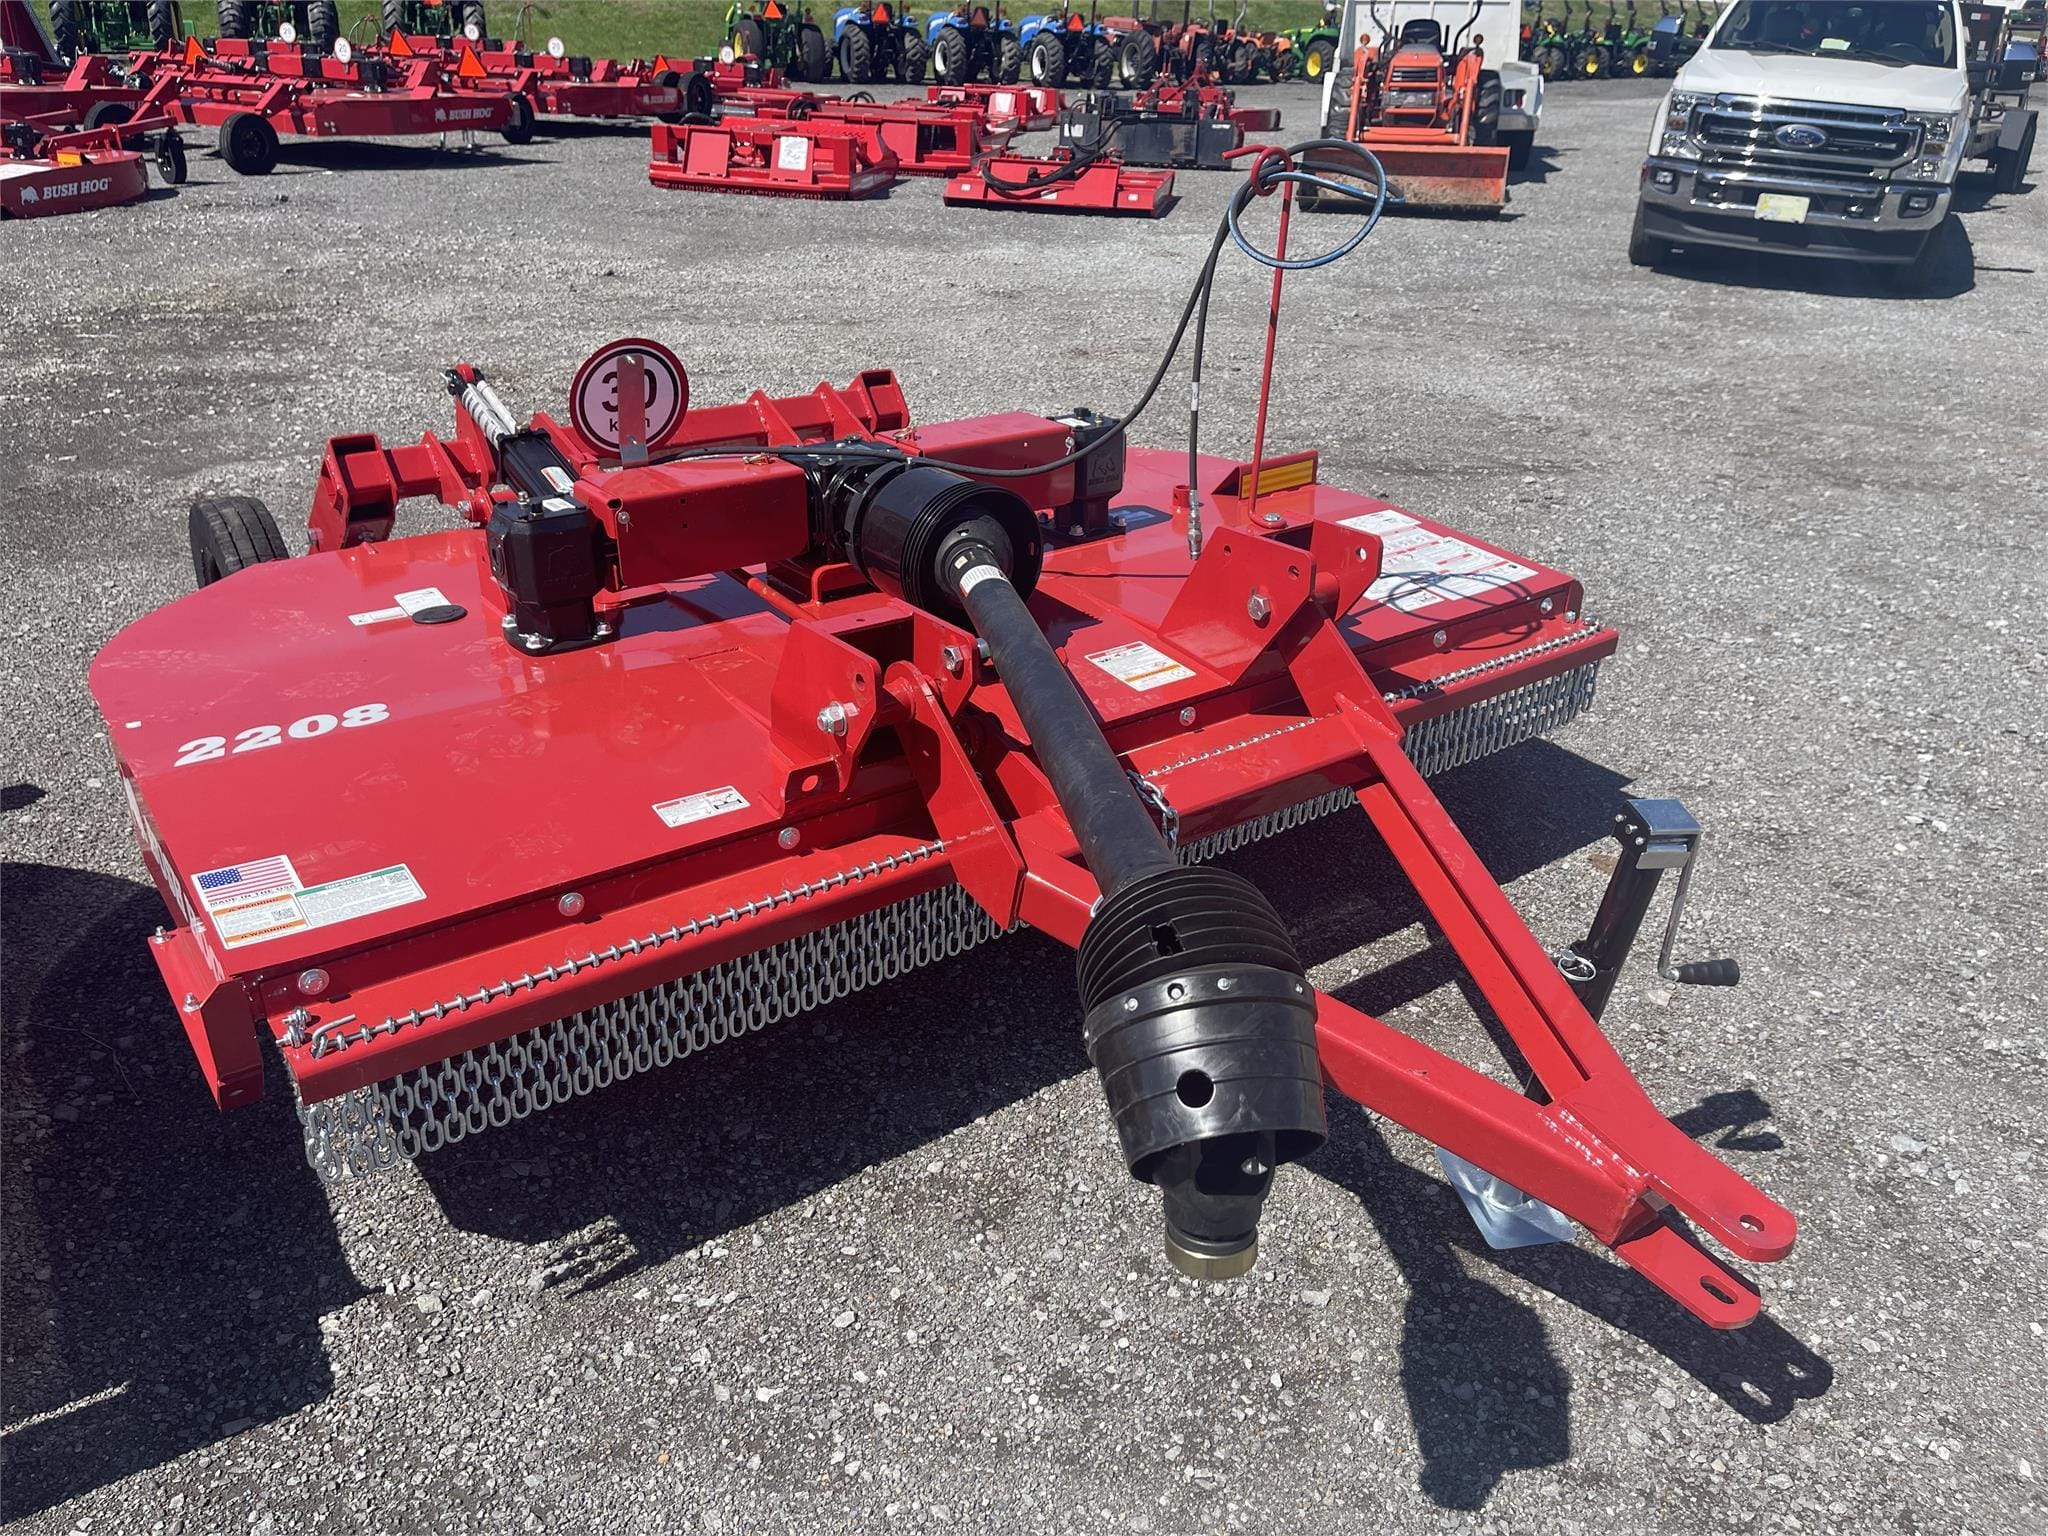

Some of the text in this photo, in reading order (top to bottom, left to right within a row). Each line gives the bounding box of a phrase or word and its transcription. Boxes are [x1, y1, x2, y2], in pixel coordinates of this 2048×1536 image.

[449, 107, 491, 120] BUSH HOG
[43, 177, 109, 200] BUSH HOG
[174, 703, 390, 767] 2208
[325, 874, 373, 889] IMPORTANT
[210, 884, 298, 908] MADE IN THE USA
[239, 898, 279, 911] WARNING
[250, 923, 293, 937] WARNING
